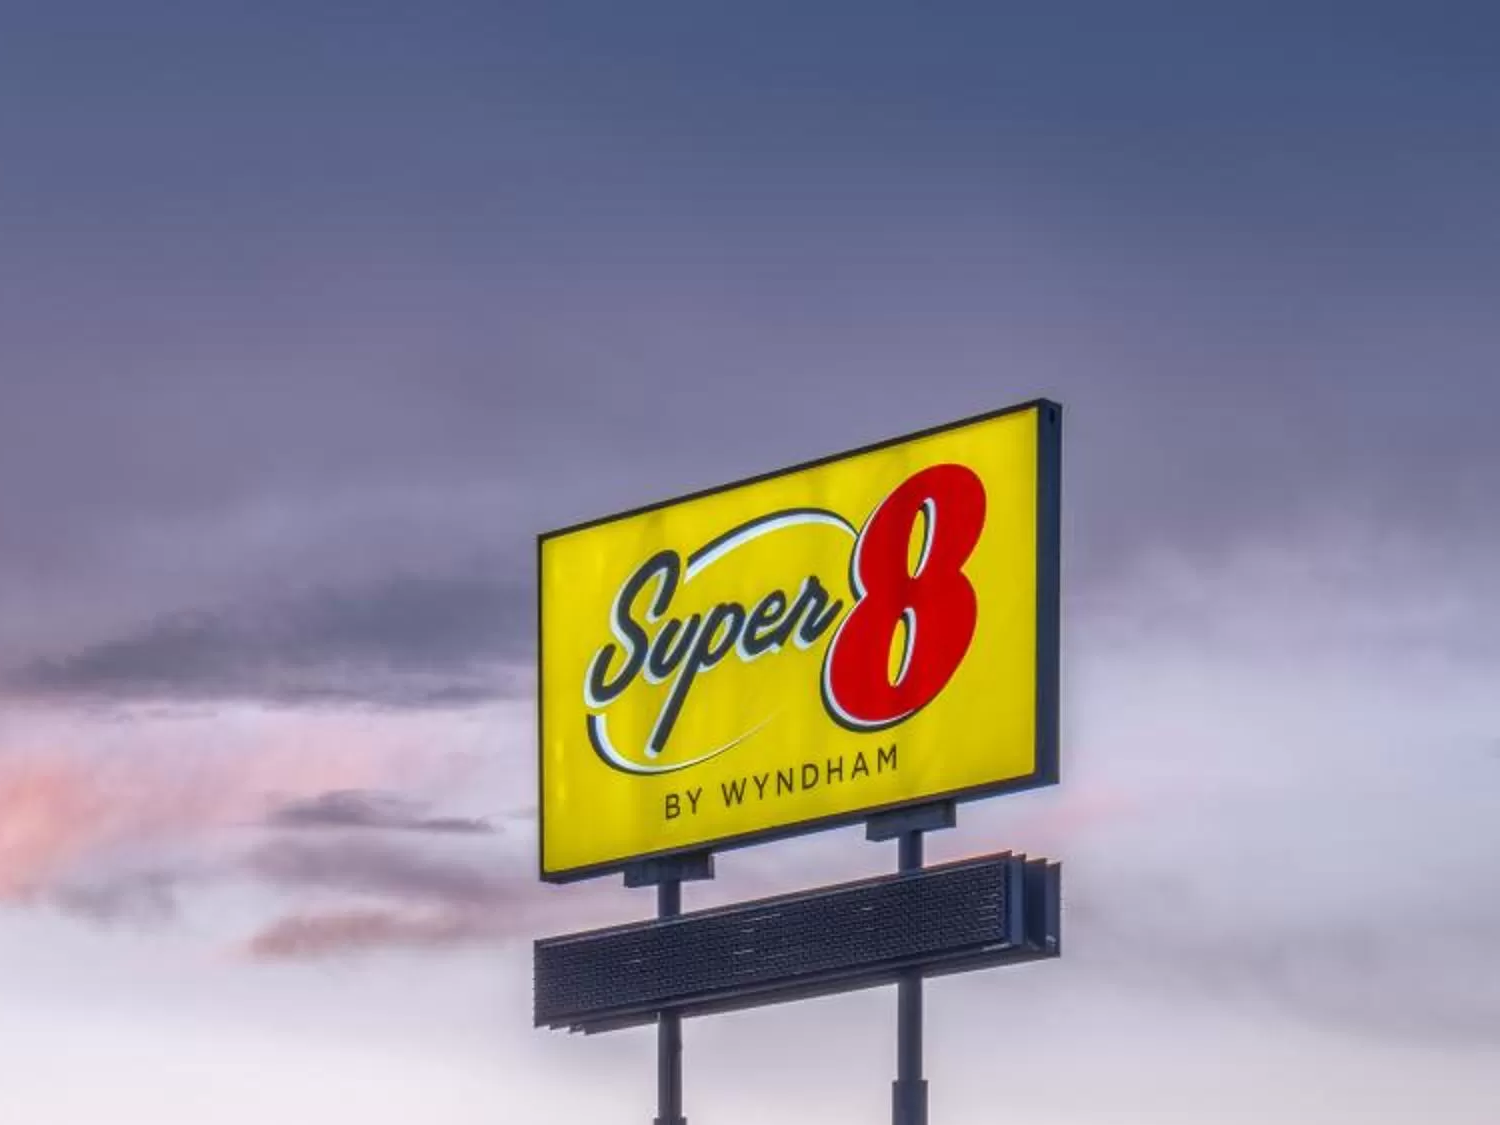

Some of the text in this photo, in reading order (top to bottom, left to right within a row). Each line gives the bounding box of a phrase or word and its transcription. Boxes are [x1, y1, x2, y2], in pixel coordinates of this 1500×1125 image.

[584, 463, 987, 759] Super 8
[665, 743, 898, 820] BY WYNDHAM
